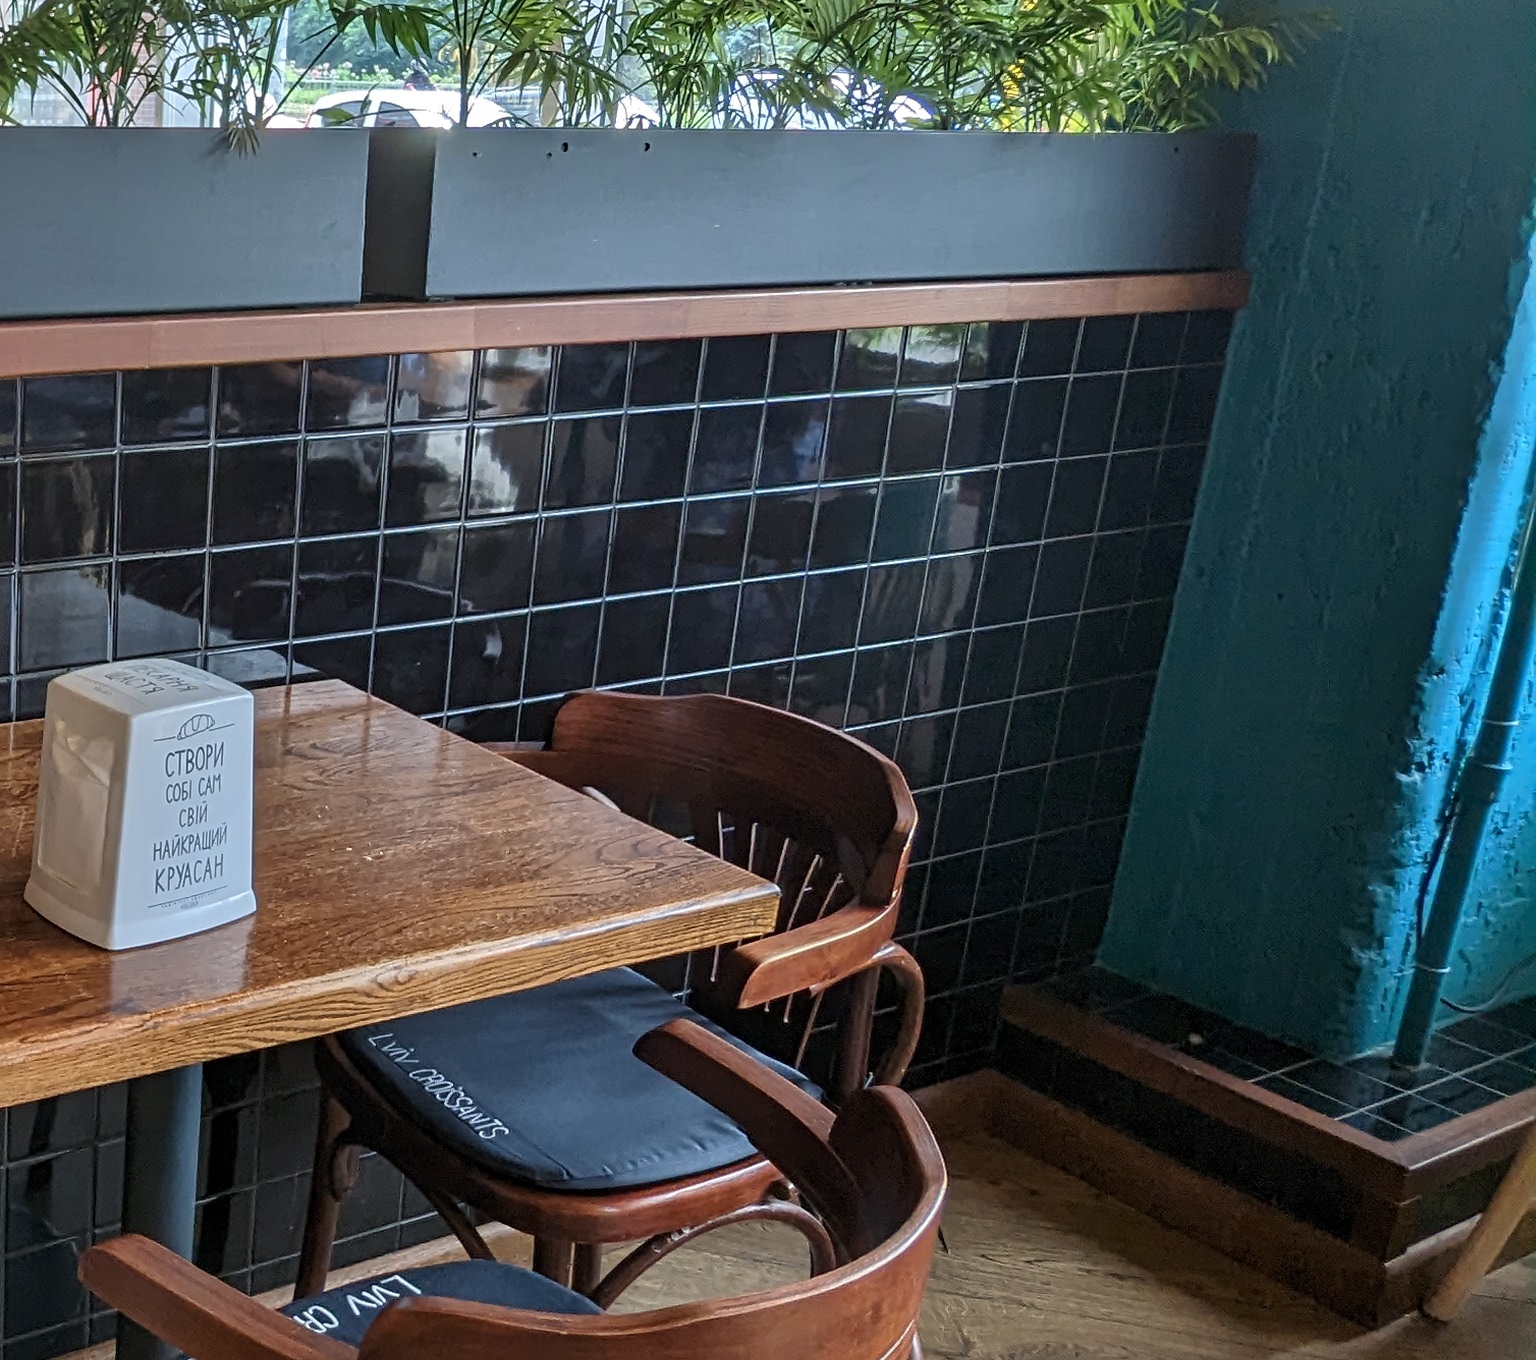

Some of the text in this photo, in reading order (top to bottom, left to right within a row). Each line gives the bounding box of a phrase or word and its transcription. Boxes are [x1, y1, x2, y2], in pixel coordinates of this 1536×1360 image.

[165, 741, 224, 778] СТВОРИ
[165, 773, 221, 804] СОБІ САМ
[178, 800, 208, 828] СВІЙ
[155, 853, 224, 894] КРУАСАН
